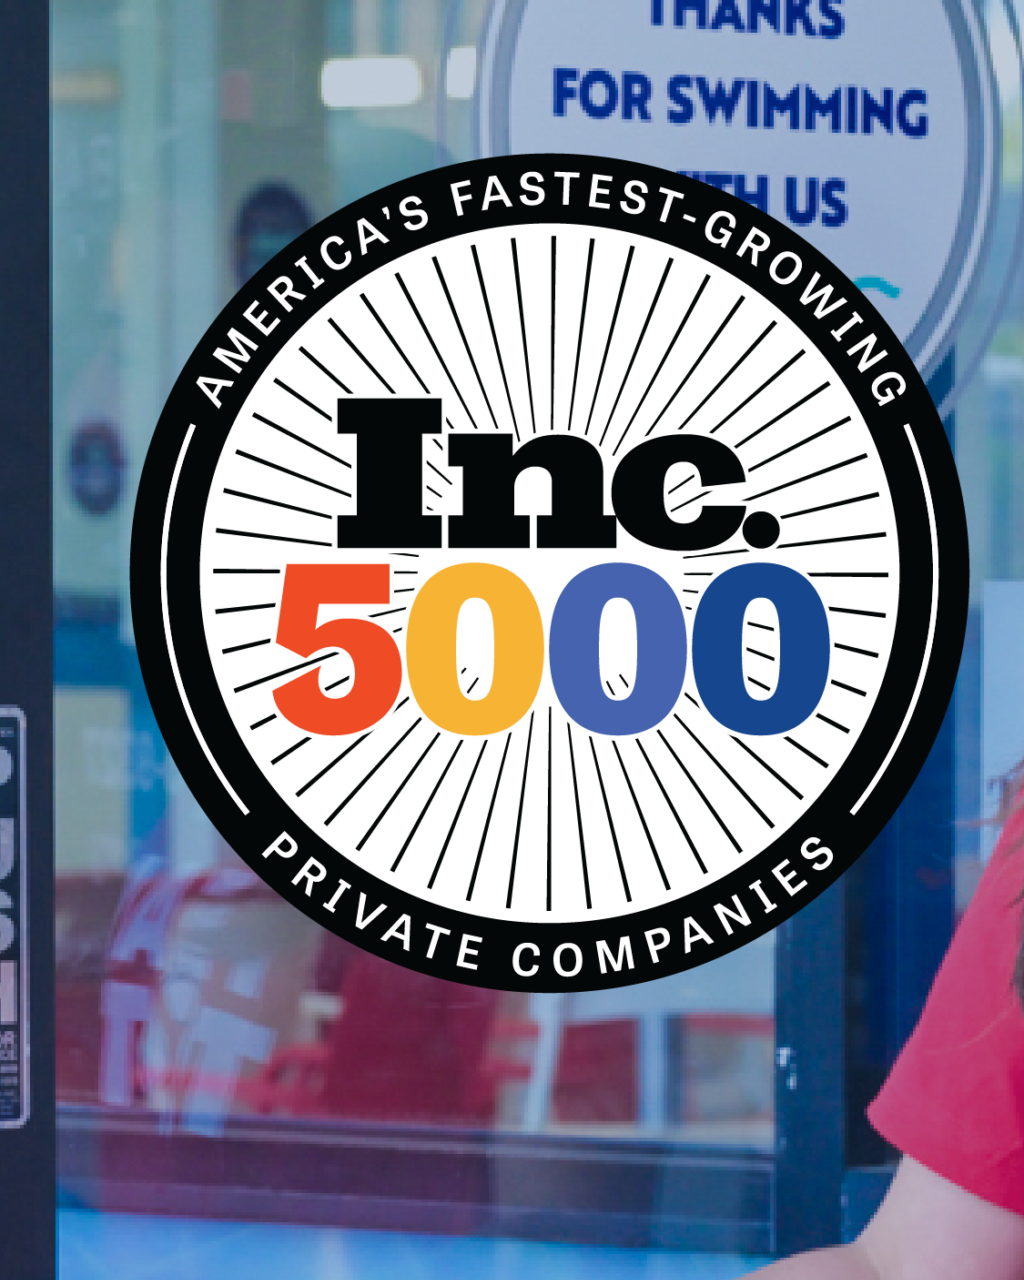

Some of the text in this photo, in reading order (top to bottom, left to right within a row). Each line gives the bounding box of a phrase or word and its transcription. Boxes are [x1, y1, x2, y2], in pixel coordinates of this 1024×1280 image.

[552, 66, 929, 139] FOR SWIMMING
[785, 175, 849, 228] US
